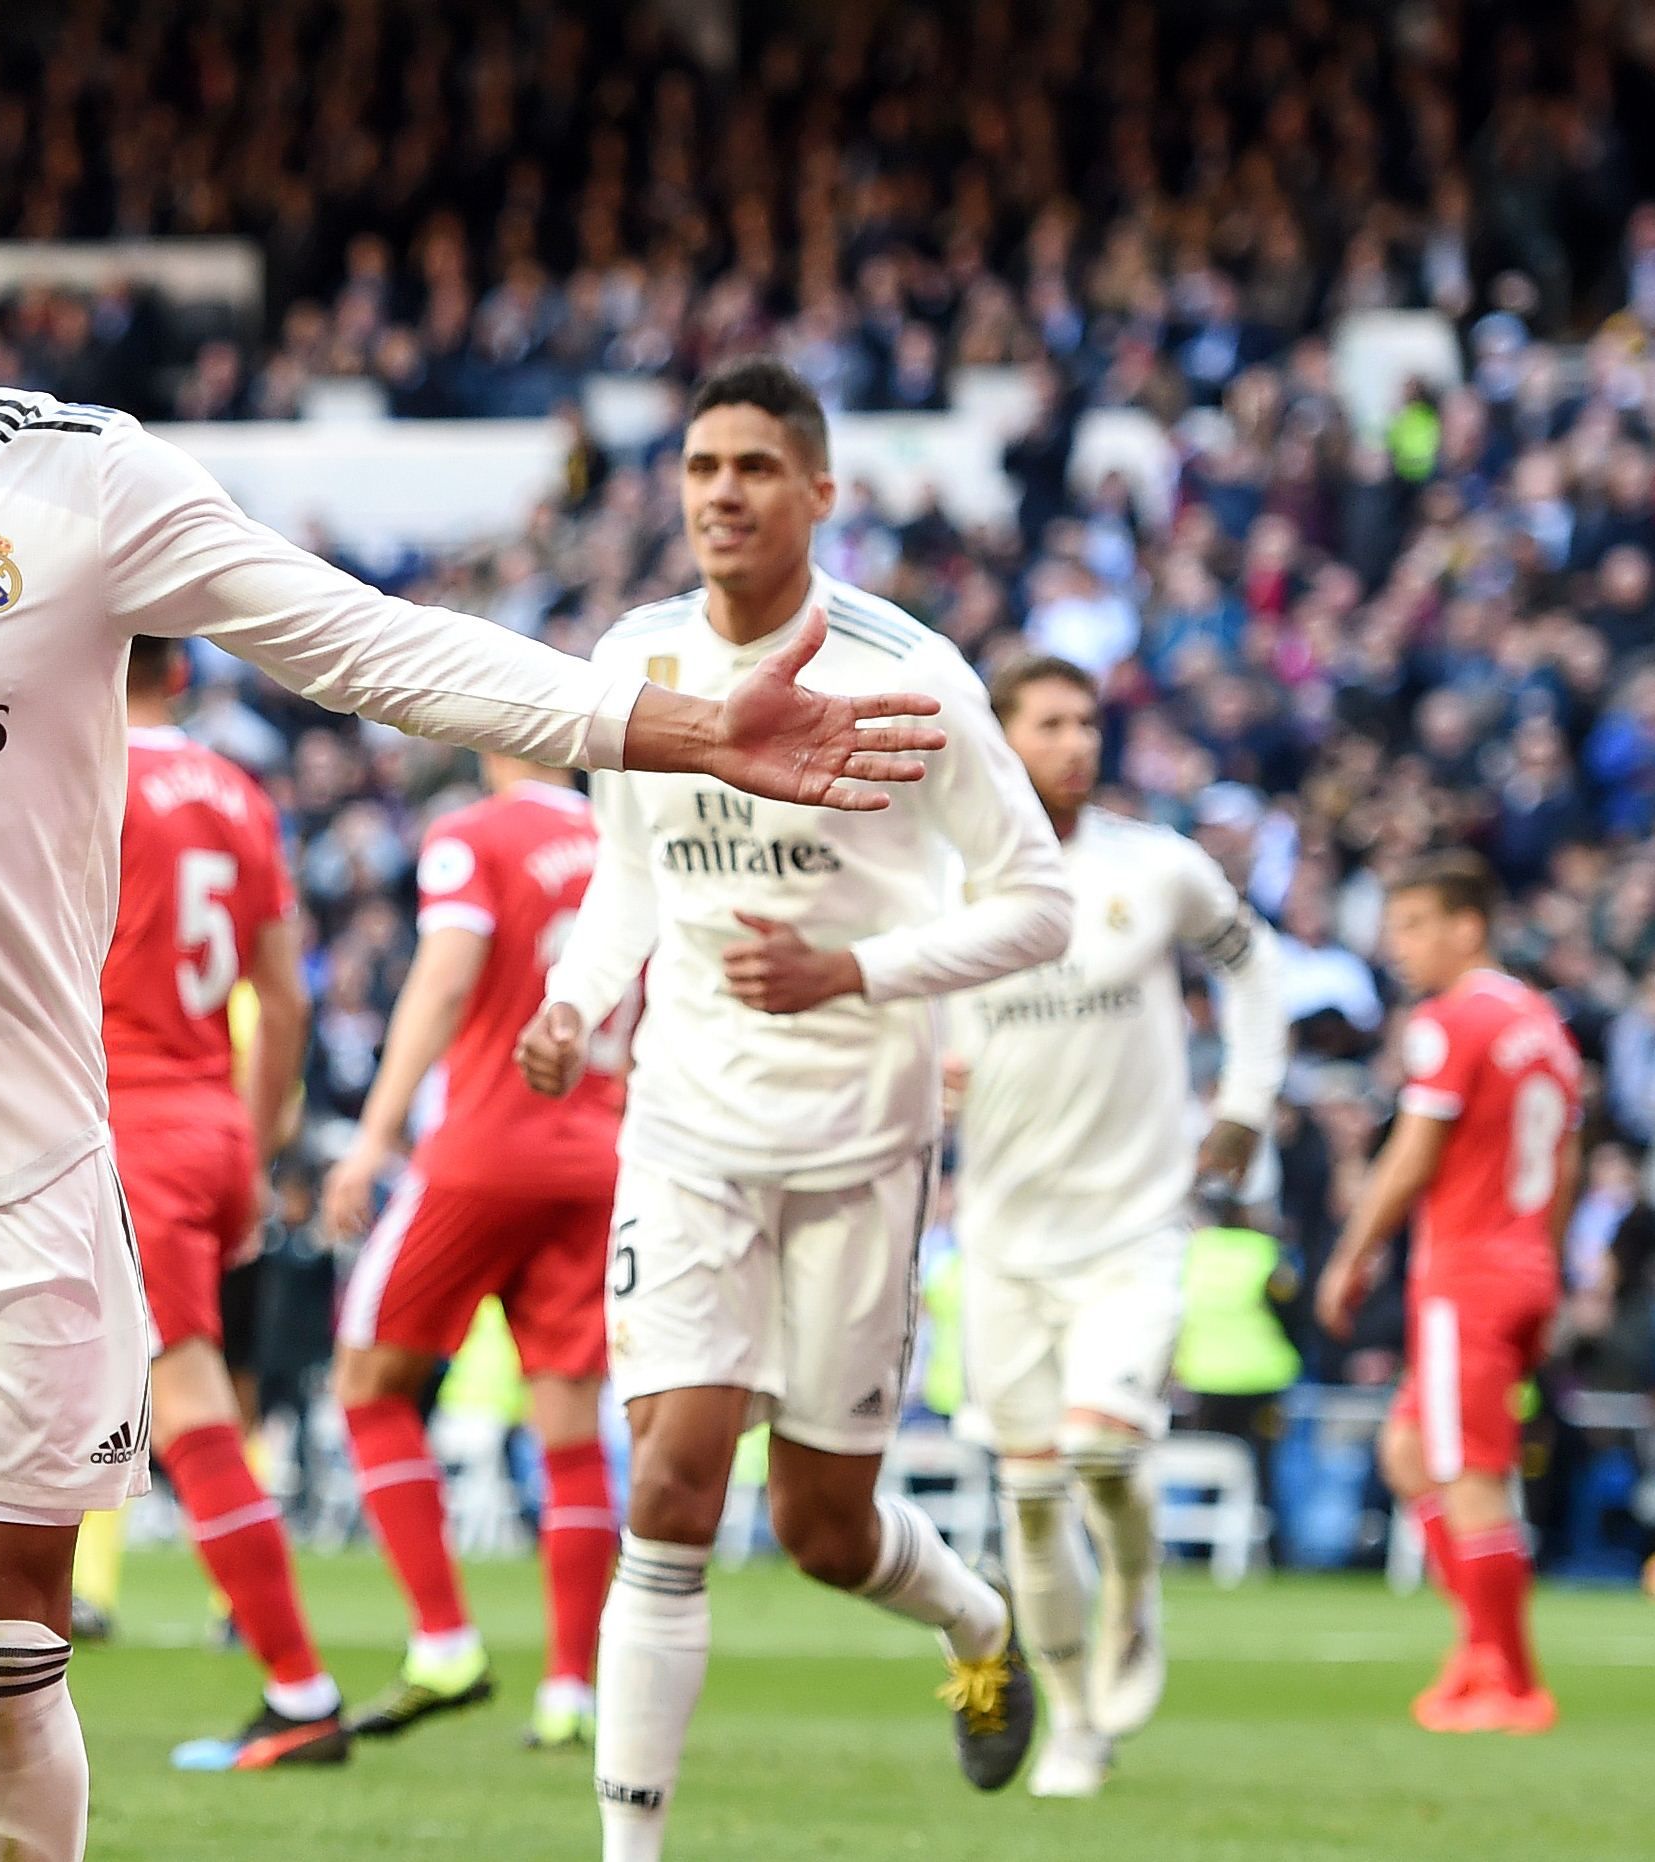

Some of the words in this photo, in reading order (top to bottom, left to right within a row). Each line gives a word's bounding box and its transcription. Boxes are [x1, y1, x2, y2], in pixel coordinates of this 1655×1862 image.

[695, 790, 754, 828] Fly
[644, 823, 843, 878] mirates
[175, 847, 240, 1021] 5
